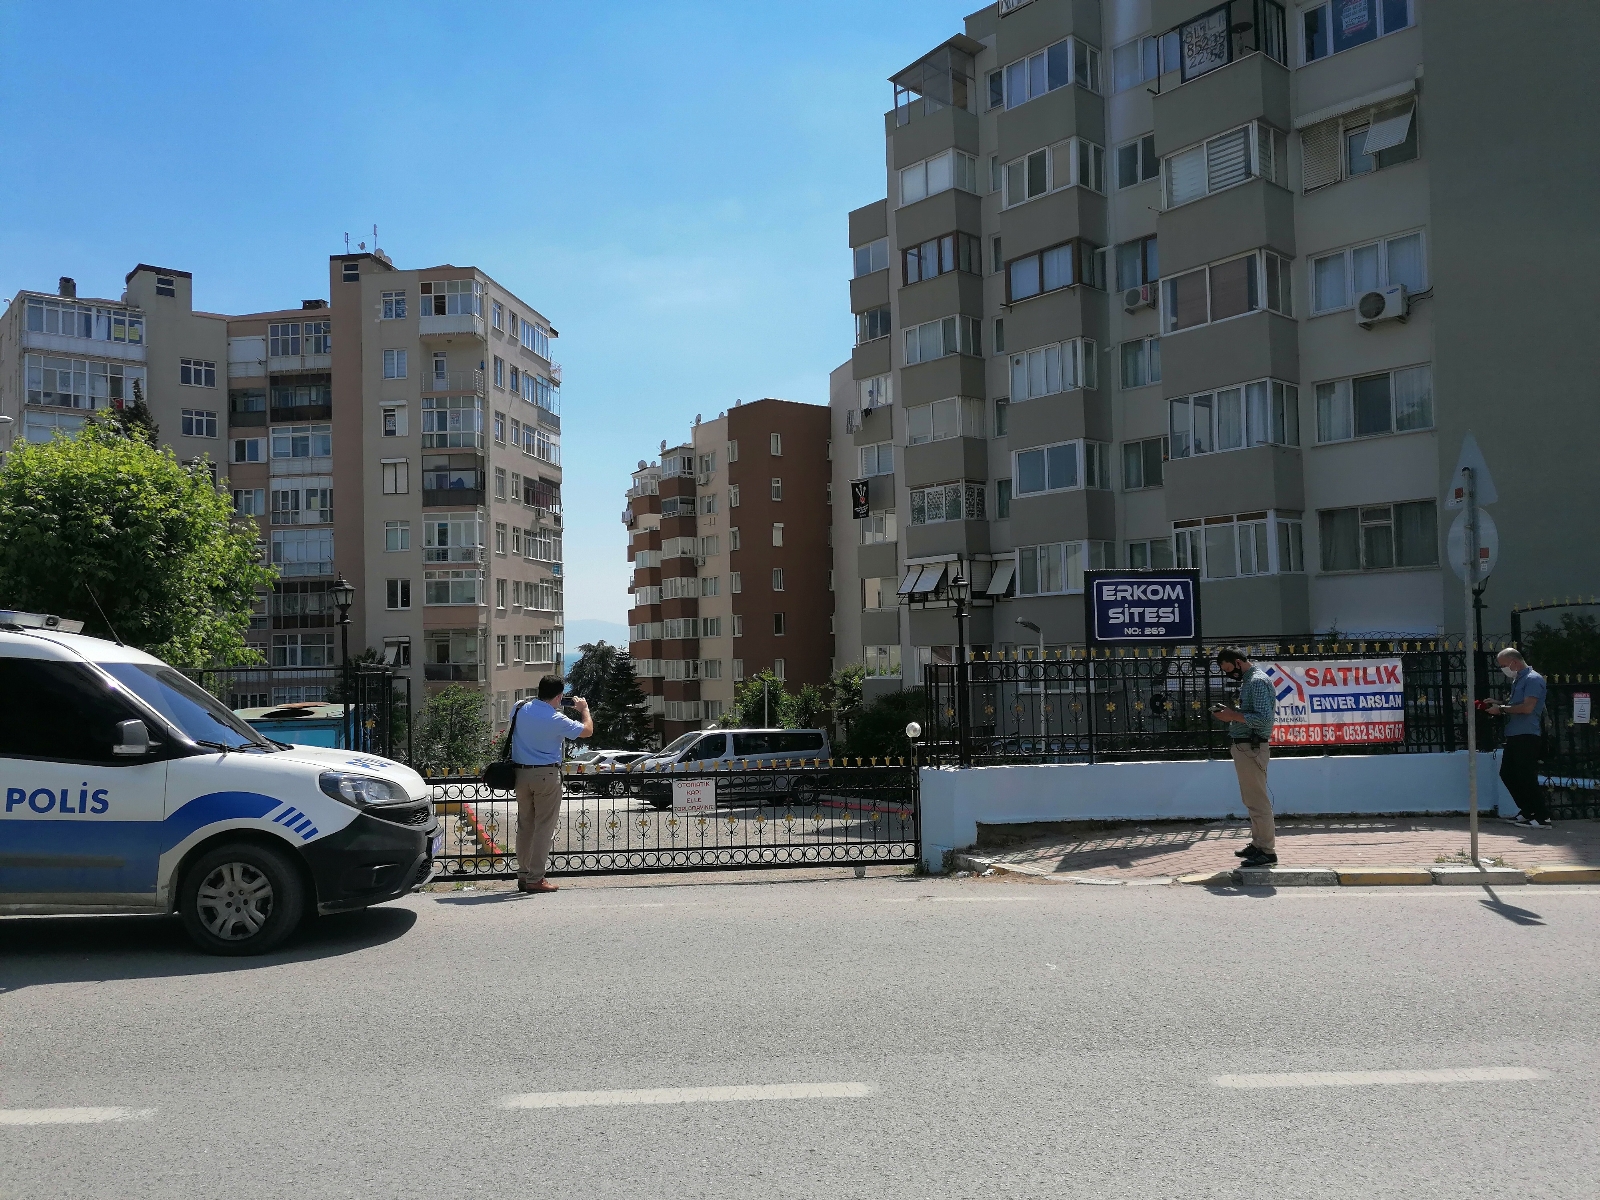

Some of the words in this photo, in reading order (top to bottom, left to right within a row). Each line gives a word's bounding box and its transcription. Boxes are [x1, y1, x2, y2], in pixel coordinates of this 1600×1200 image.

[1102, 585, 1184, 601] ERKOM
[1108, 603, 1180, 624] SİTESİ
[1144, 627, 1166, 635] 269
[1305, 665, 1400, 687] SATILIK
[1275, 703, 1307, 715] NTİM
[1313, 697, 1356, 710] ENVER
[1360, 695, 1402, 708] ARSLAN
[1271, 728, 1286, 742] 16
[1287, 727, 1306, 742] 456
[1308, 726, 1320, 741] 50
[1322, 725, 1336, 741] 56
[1343, 725, 1368, 741] 0532
[1368, 724, 1385, 740] 543
[5, 781, 110, 815] POLİS
